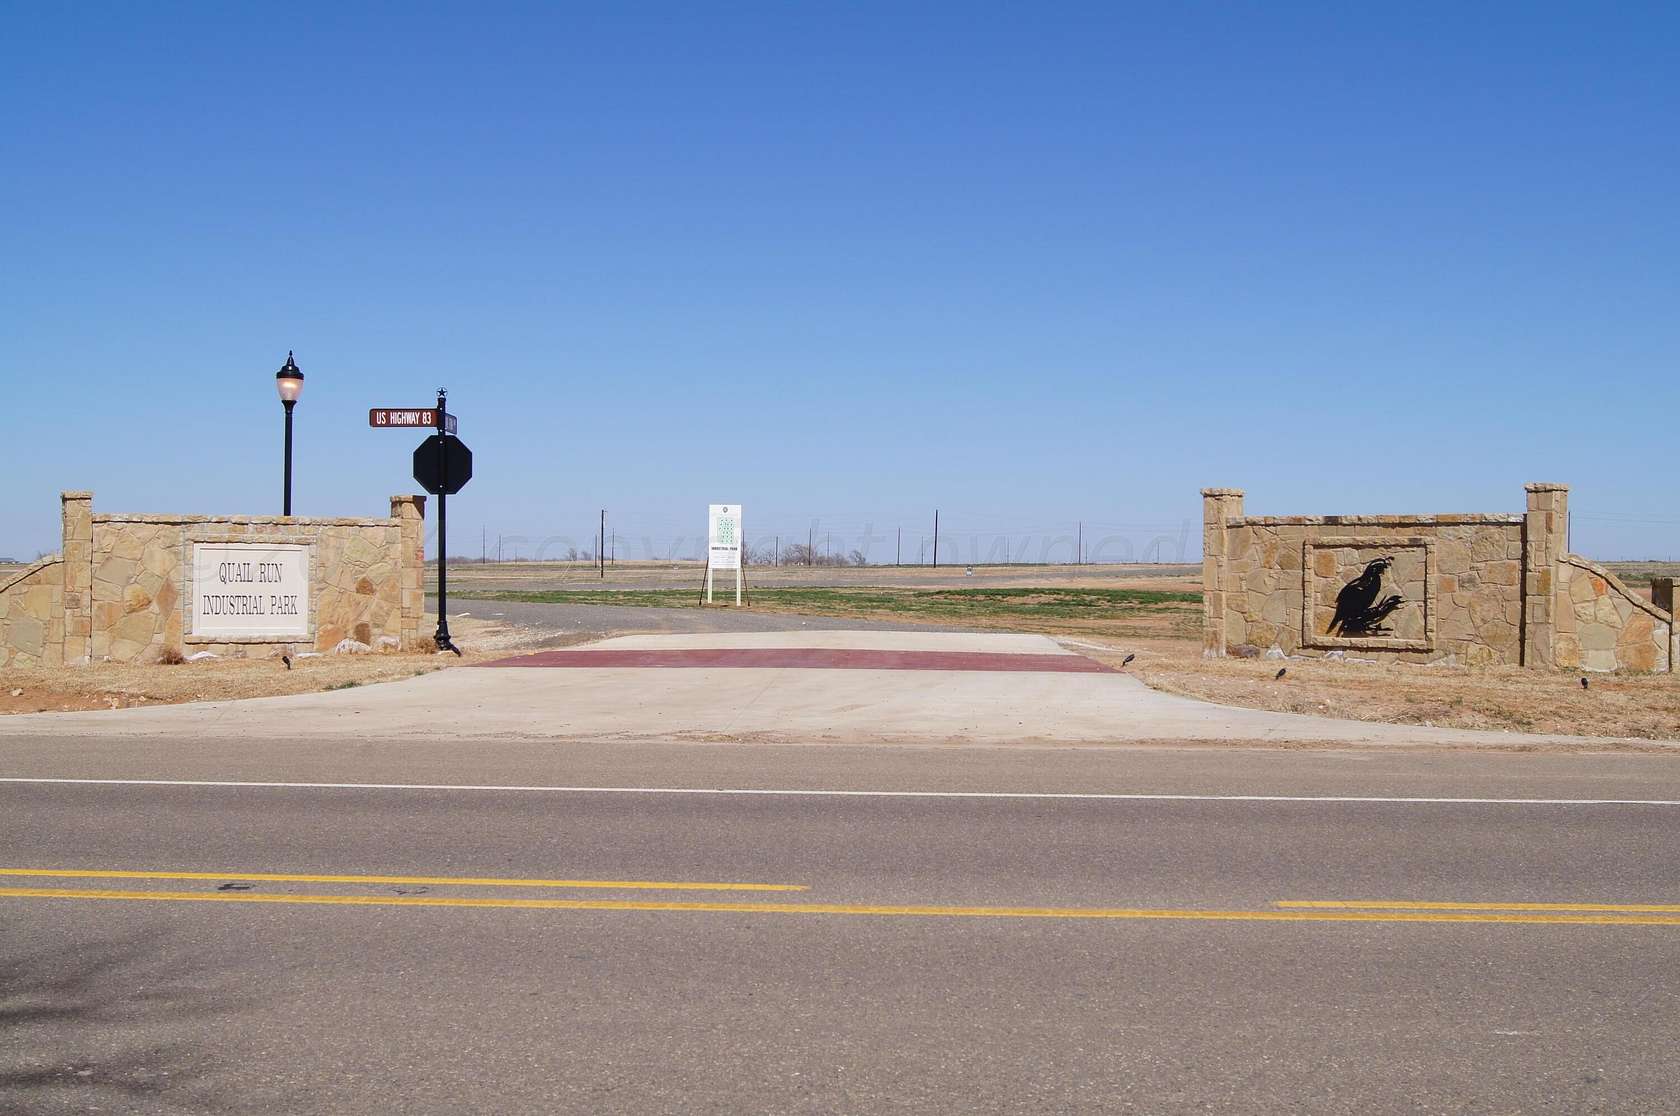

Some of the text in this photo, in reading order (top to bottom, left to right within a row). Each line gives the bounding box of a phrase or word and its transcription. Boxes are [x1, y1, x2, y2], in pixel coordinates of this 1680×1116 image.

[376, 411, 432, 424] US HIGHWAY 83
[219, 562, 283, 584] QUAIL RUN
[202, 595, 298, 615] INDUSTRIAL PARK
